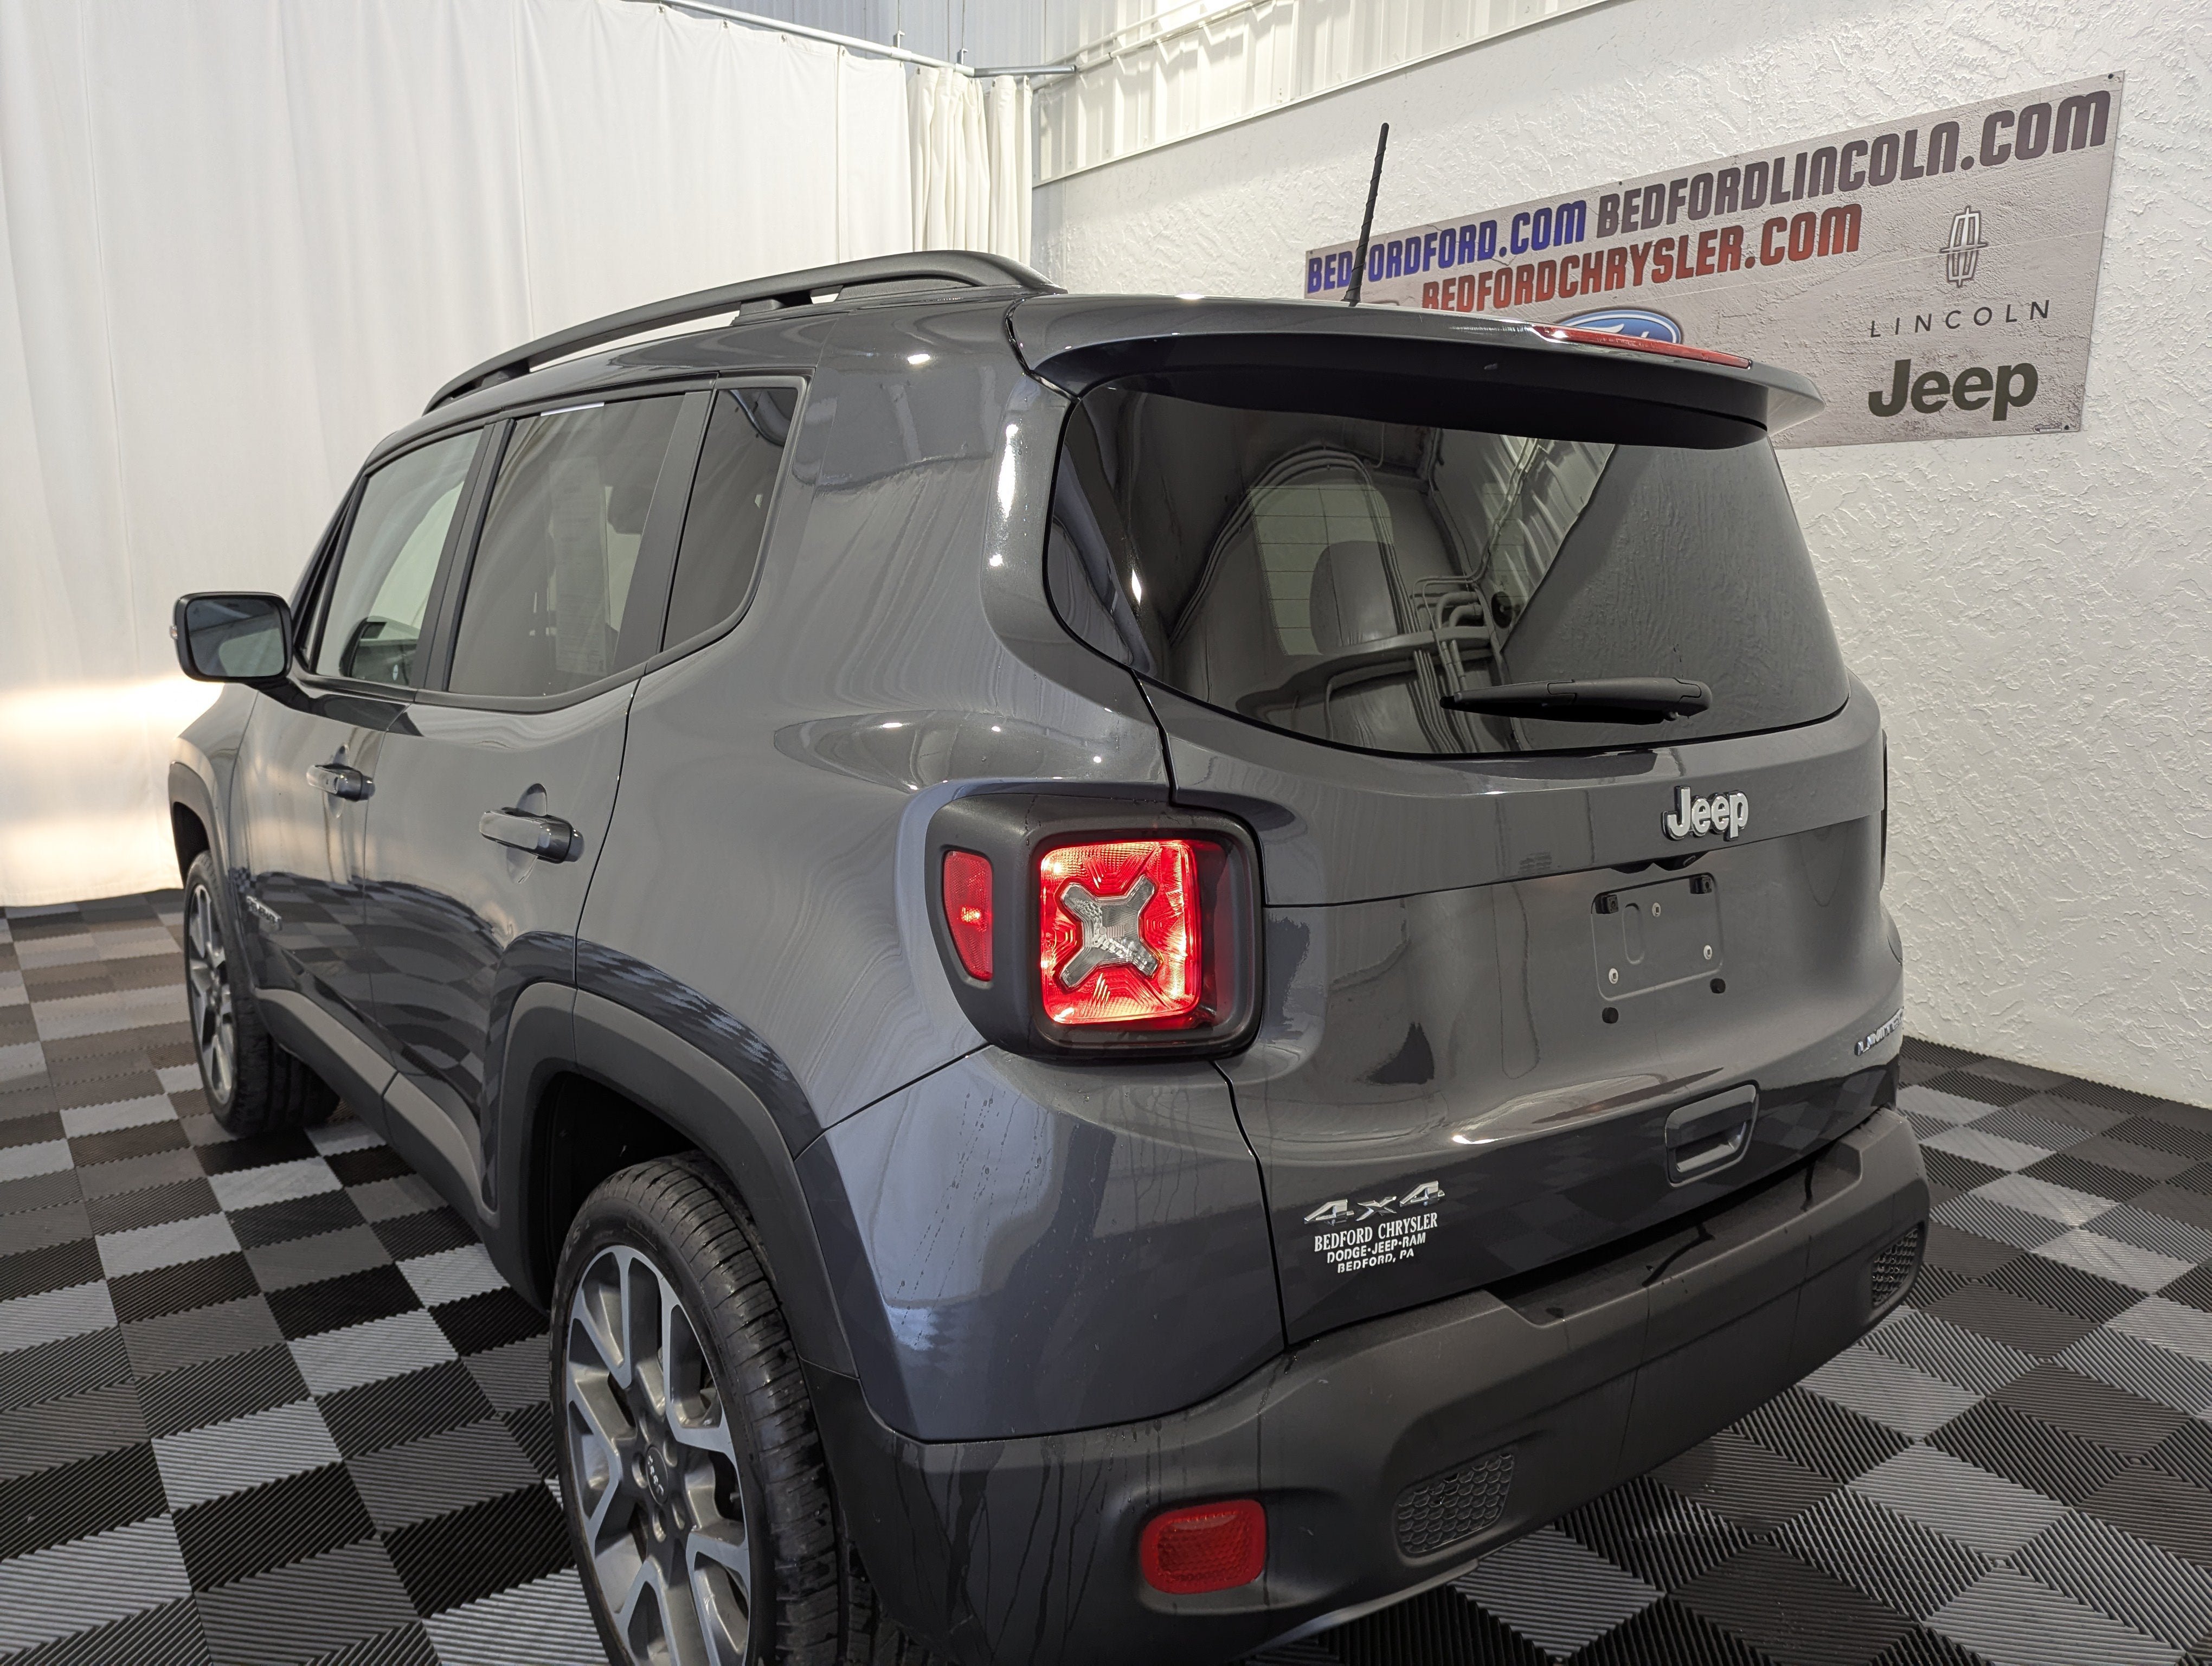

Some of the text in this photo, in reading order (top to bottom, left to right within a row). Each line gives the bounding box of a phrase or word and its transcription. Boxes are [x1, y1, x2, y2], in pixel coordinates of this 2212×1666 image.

[1307, 90, 2111, 293] BEDORDFORD.COM BEDFORDLINCOLN.COM
[1422, 204, 1862, 312] BEDFORDCHRYSLER.COM
[1870, 299, 2050, 338] LINCOLN
[1868, 359, 2039, 421] Jeep
[1661, 785, 1748, 841] Jeep
[1315, 1212, 1438, 1252] BEDFORD CHRYSLER
[1338, 1248, 1414, 1273] BEDFORD, PA
